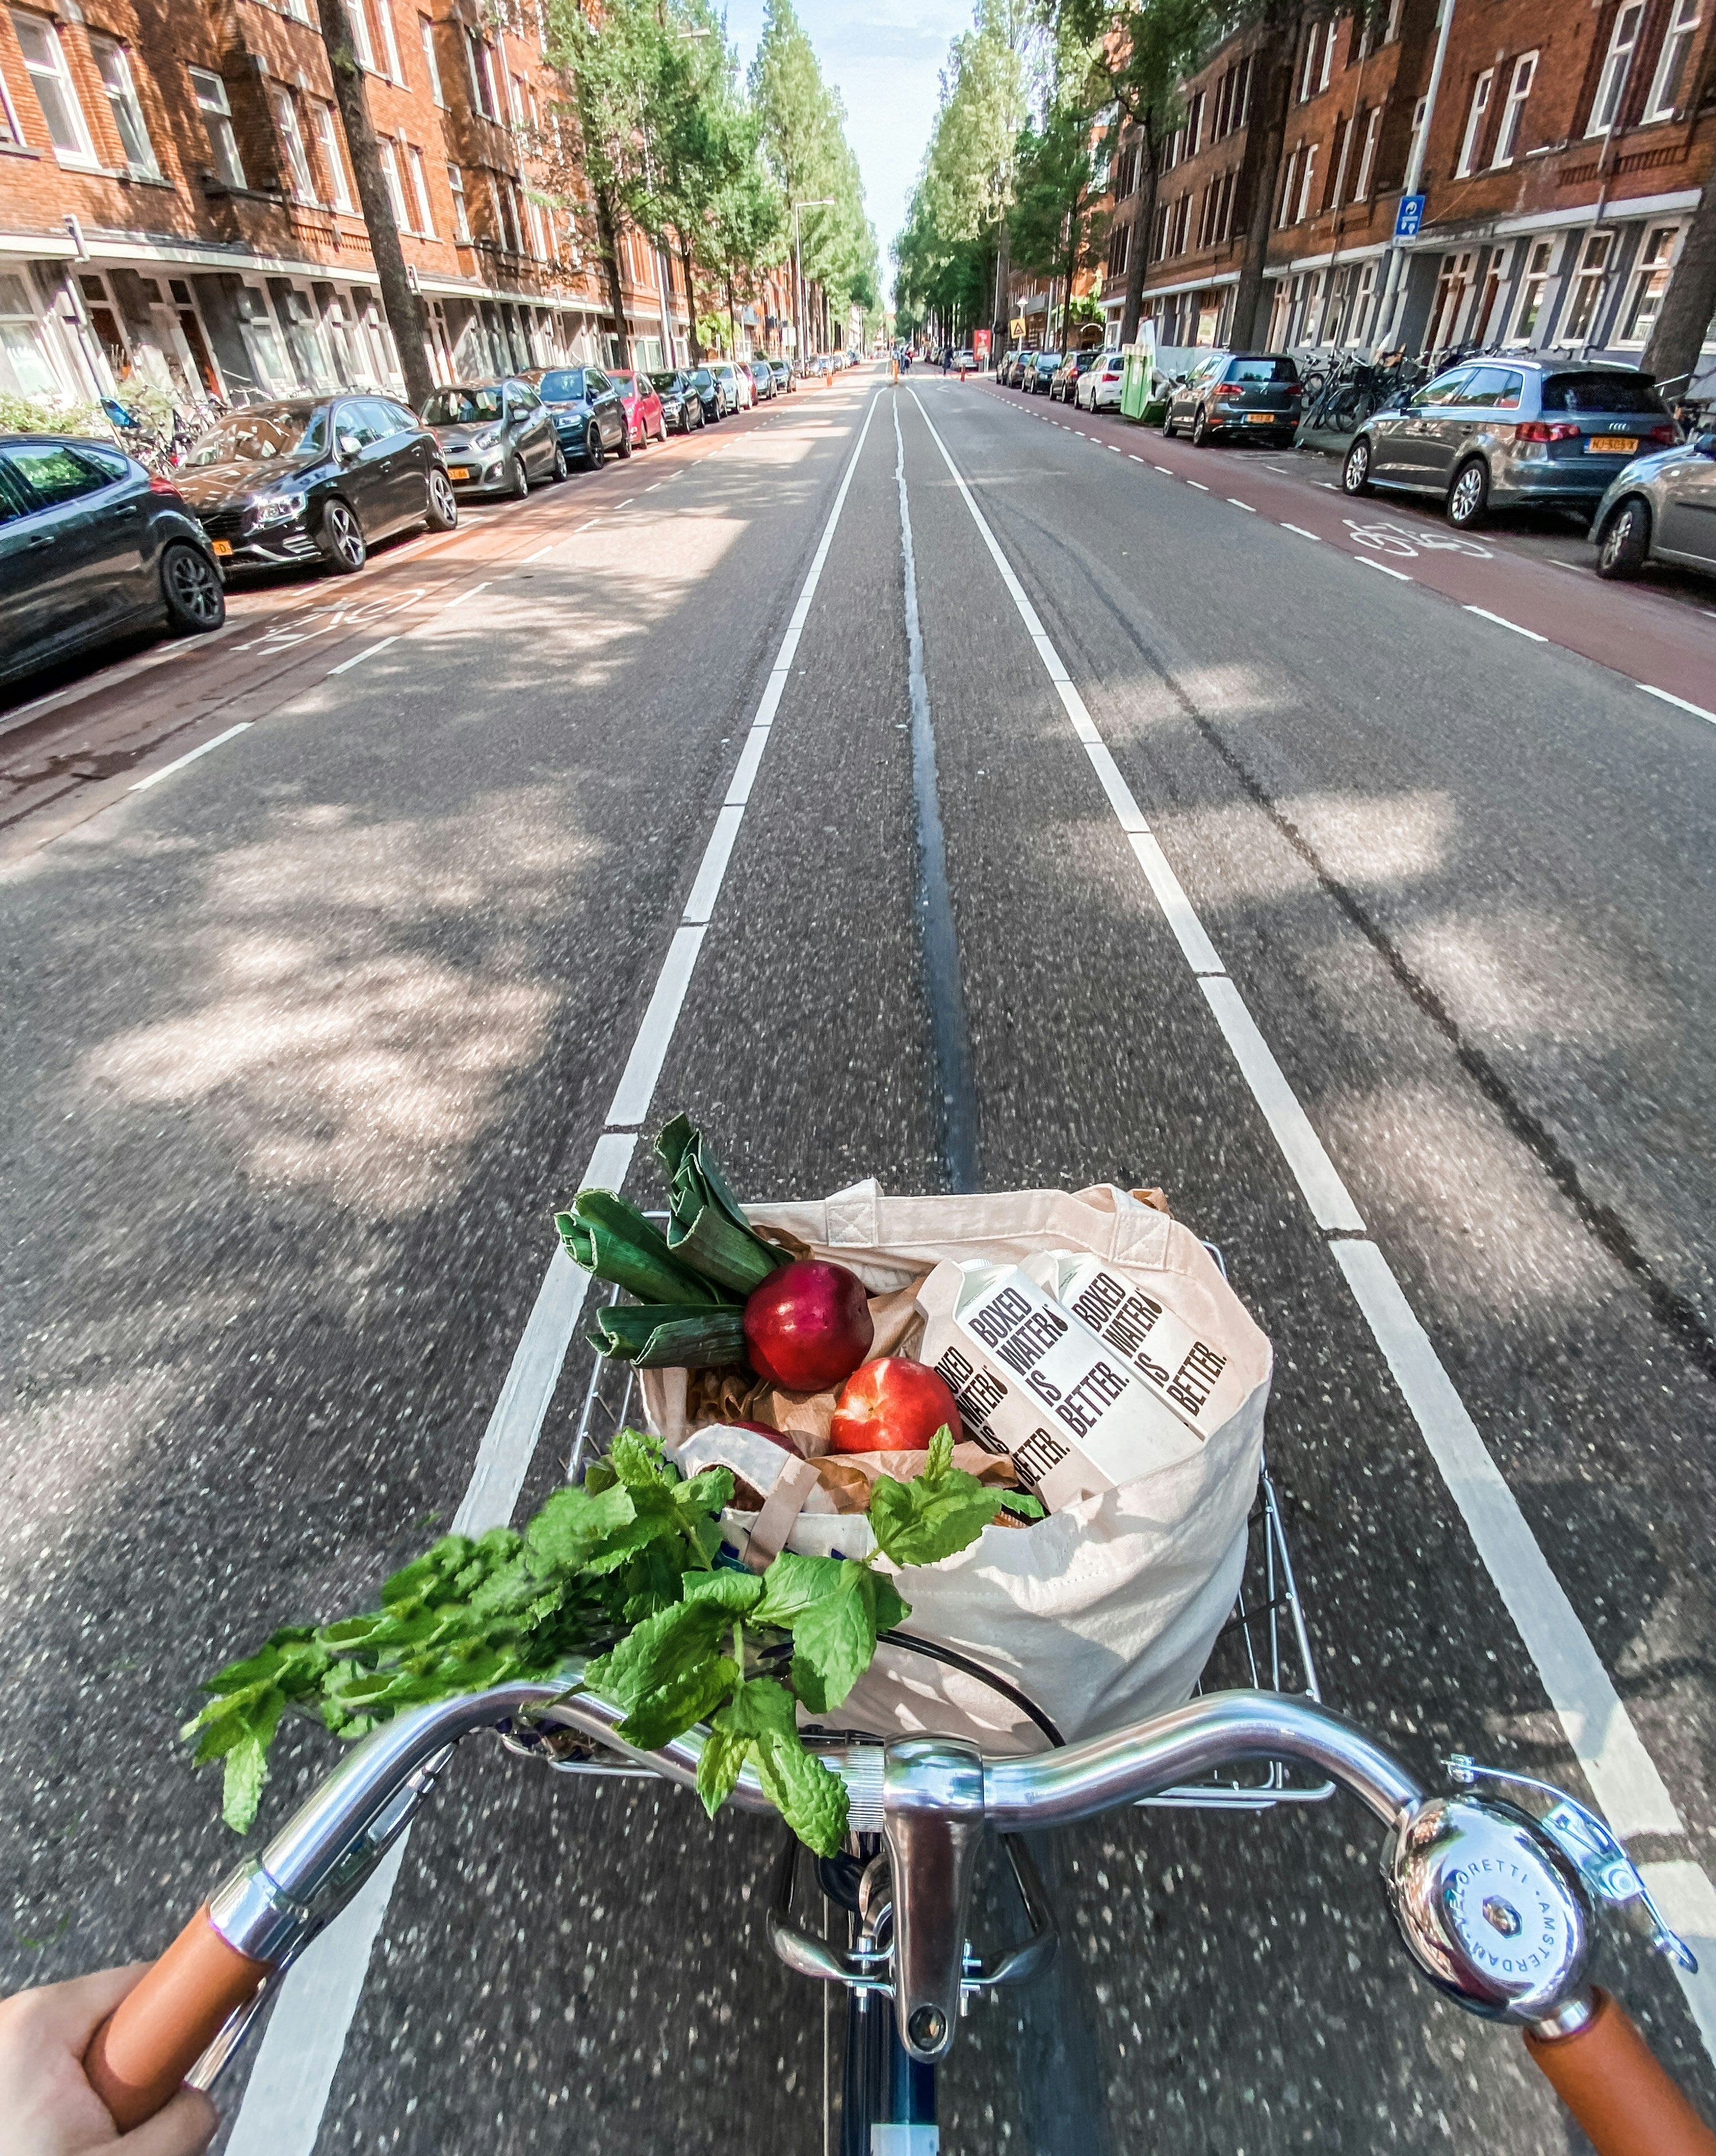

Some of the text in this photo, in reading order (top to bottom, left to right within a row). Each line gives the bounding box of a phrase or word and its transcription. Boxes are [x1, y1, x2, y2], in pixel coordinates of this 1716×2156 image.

[968, 1287, 1032, 1349] BOXED
[1071, 1272, 1126, 1333] BOXED
[1101, 1296, 1159, 1359] WATER
[933, 1346, 974, 1394] OXED
[995, 1312, 1063, 1376] WATER
[1133, 1352, 1170, 1388] IS
[956, 1373, 1004, 1427] WATER
[1025, 1370, 1062, 1407] IS
[1055, 1362, 1130, 1438] BETTER.
[1166, 1341, 1227, 1417] BETTER.
[980, 1425, 1010, 1454] IS
[1011, 1427, 1071, 1487] BETTER.
[1449, 1859, 1557, 1973] VELORETTI AMSTERDAM
